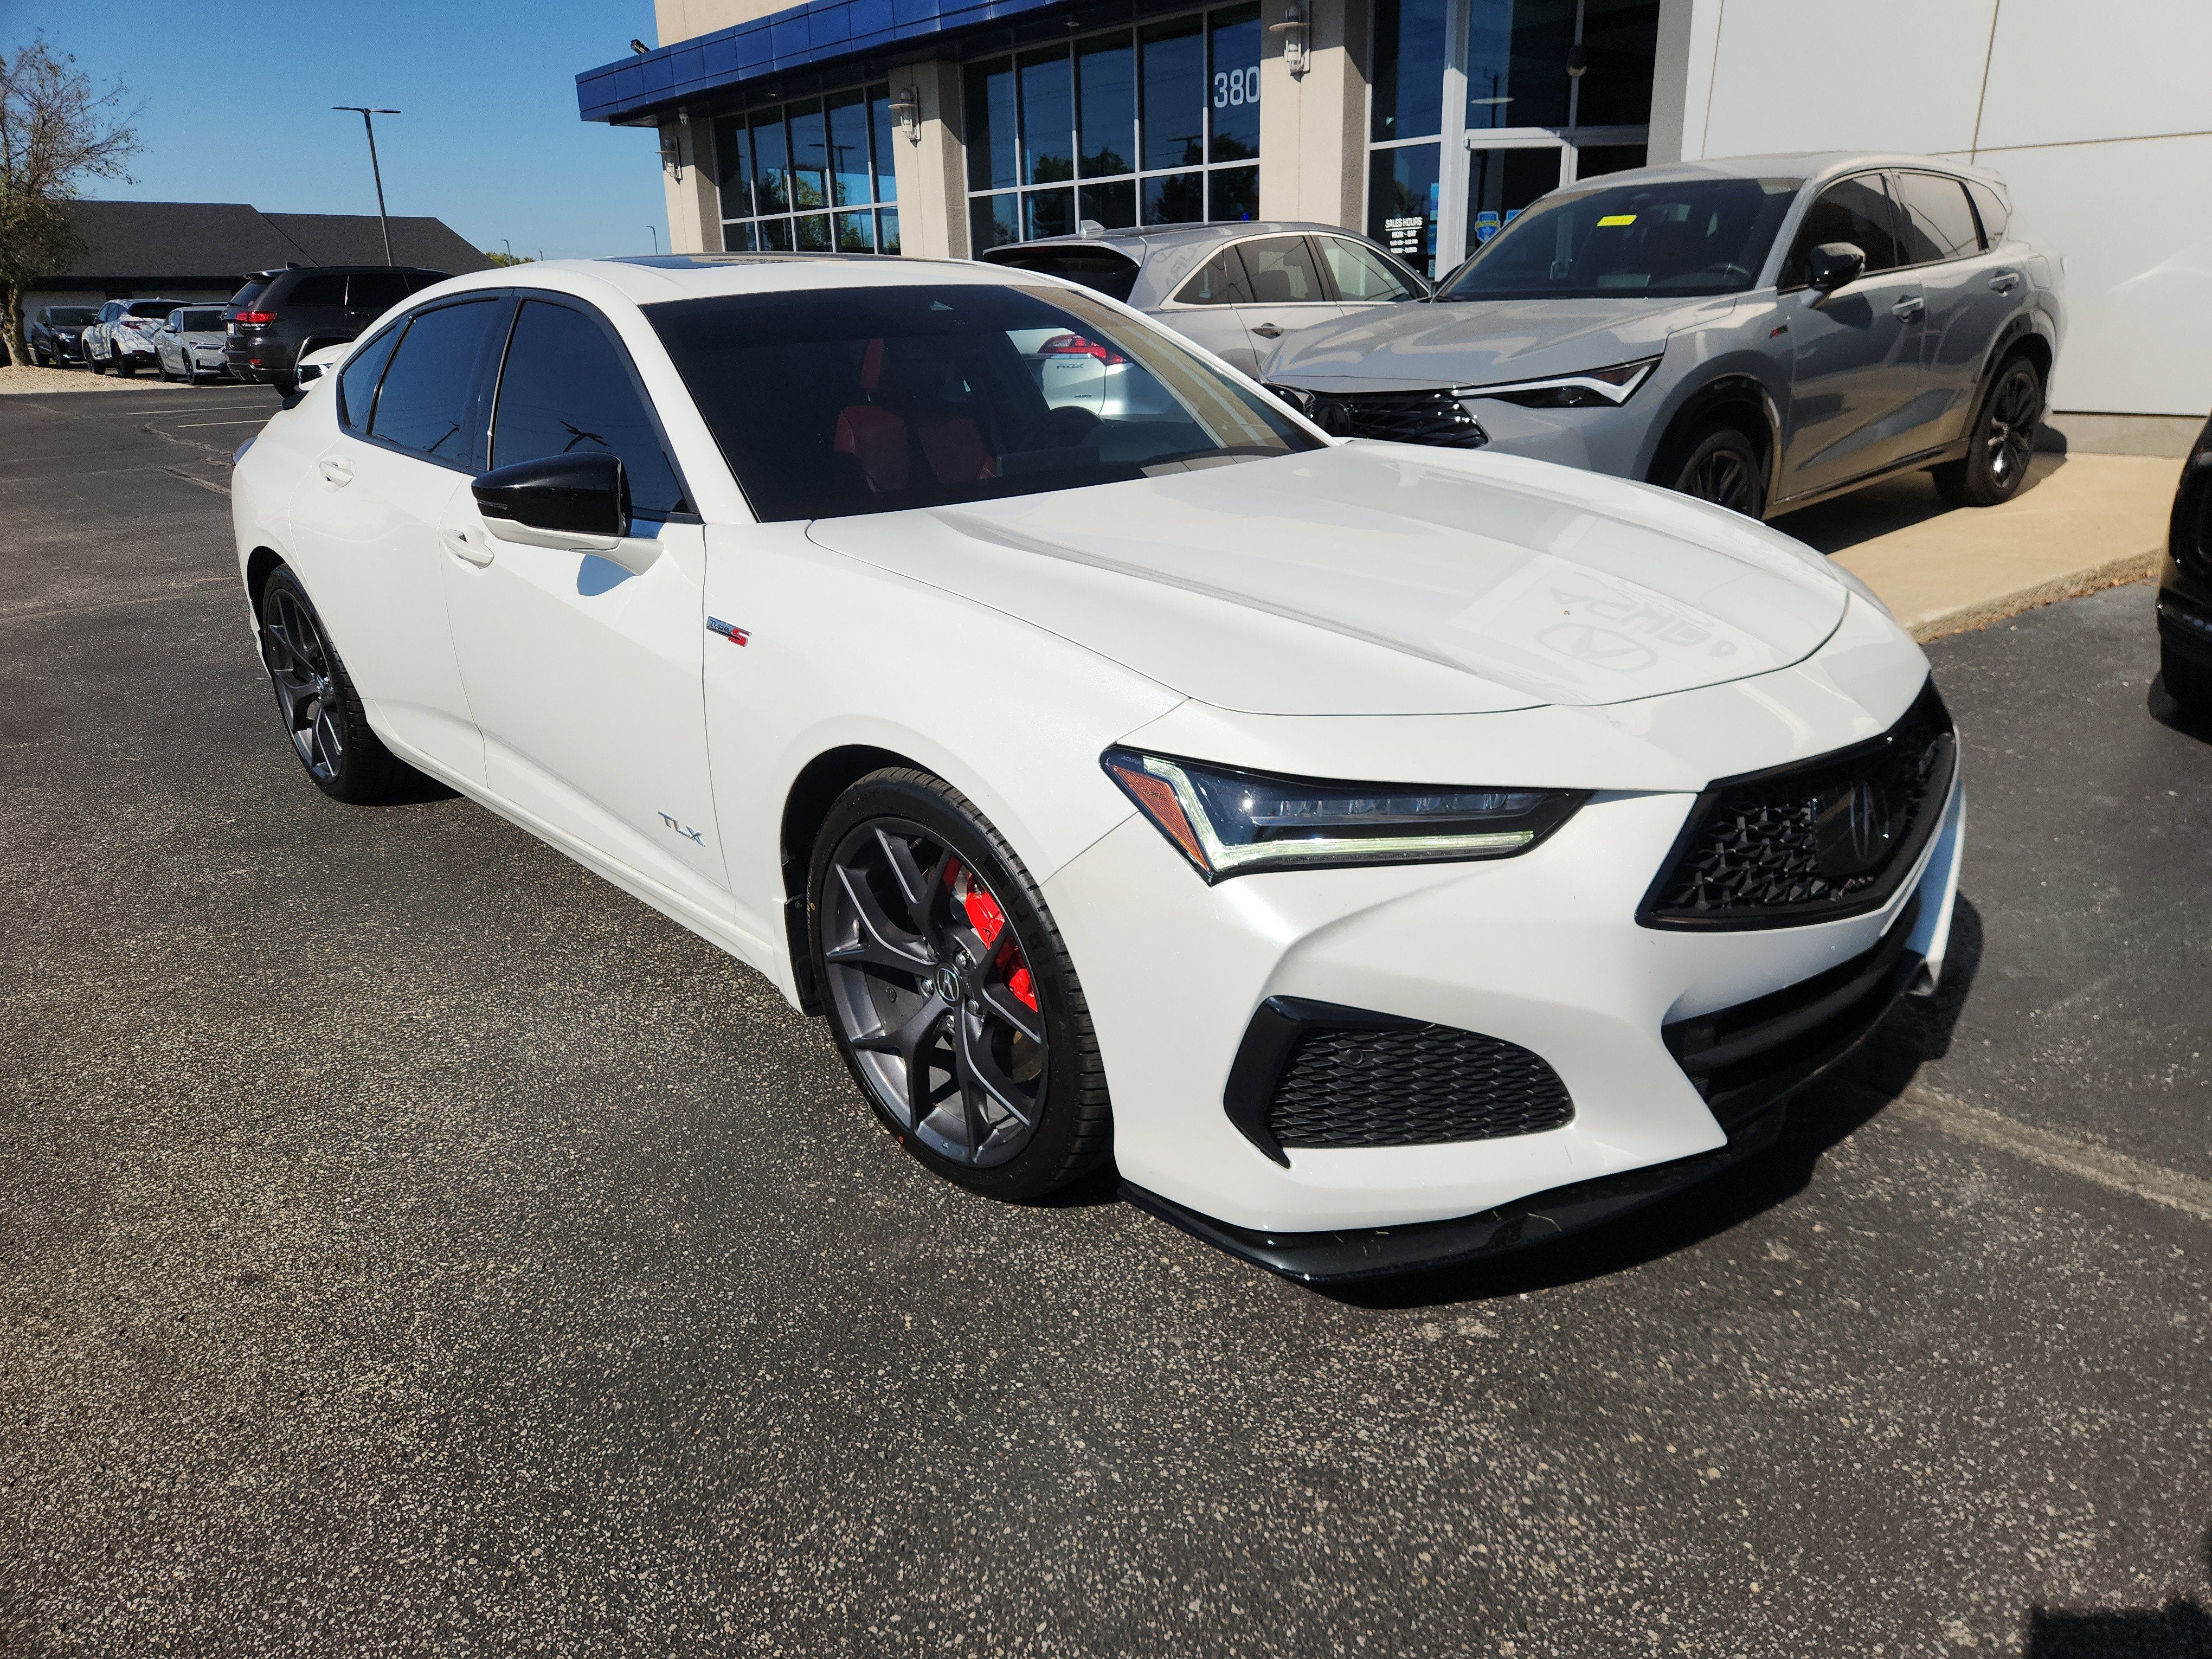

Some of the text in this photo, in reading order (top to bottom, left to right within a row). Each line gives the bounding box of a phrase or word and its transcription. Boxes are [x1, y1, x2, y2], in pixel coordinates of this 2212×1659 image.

[1214, 66, 1261, 108] 380
[1385, 216, 1423, 228] SALES HOURS
[710, 619, 753, 647] Type S
[658, 809, 706, 847] TLX
